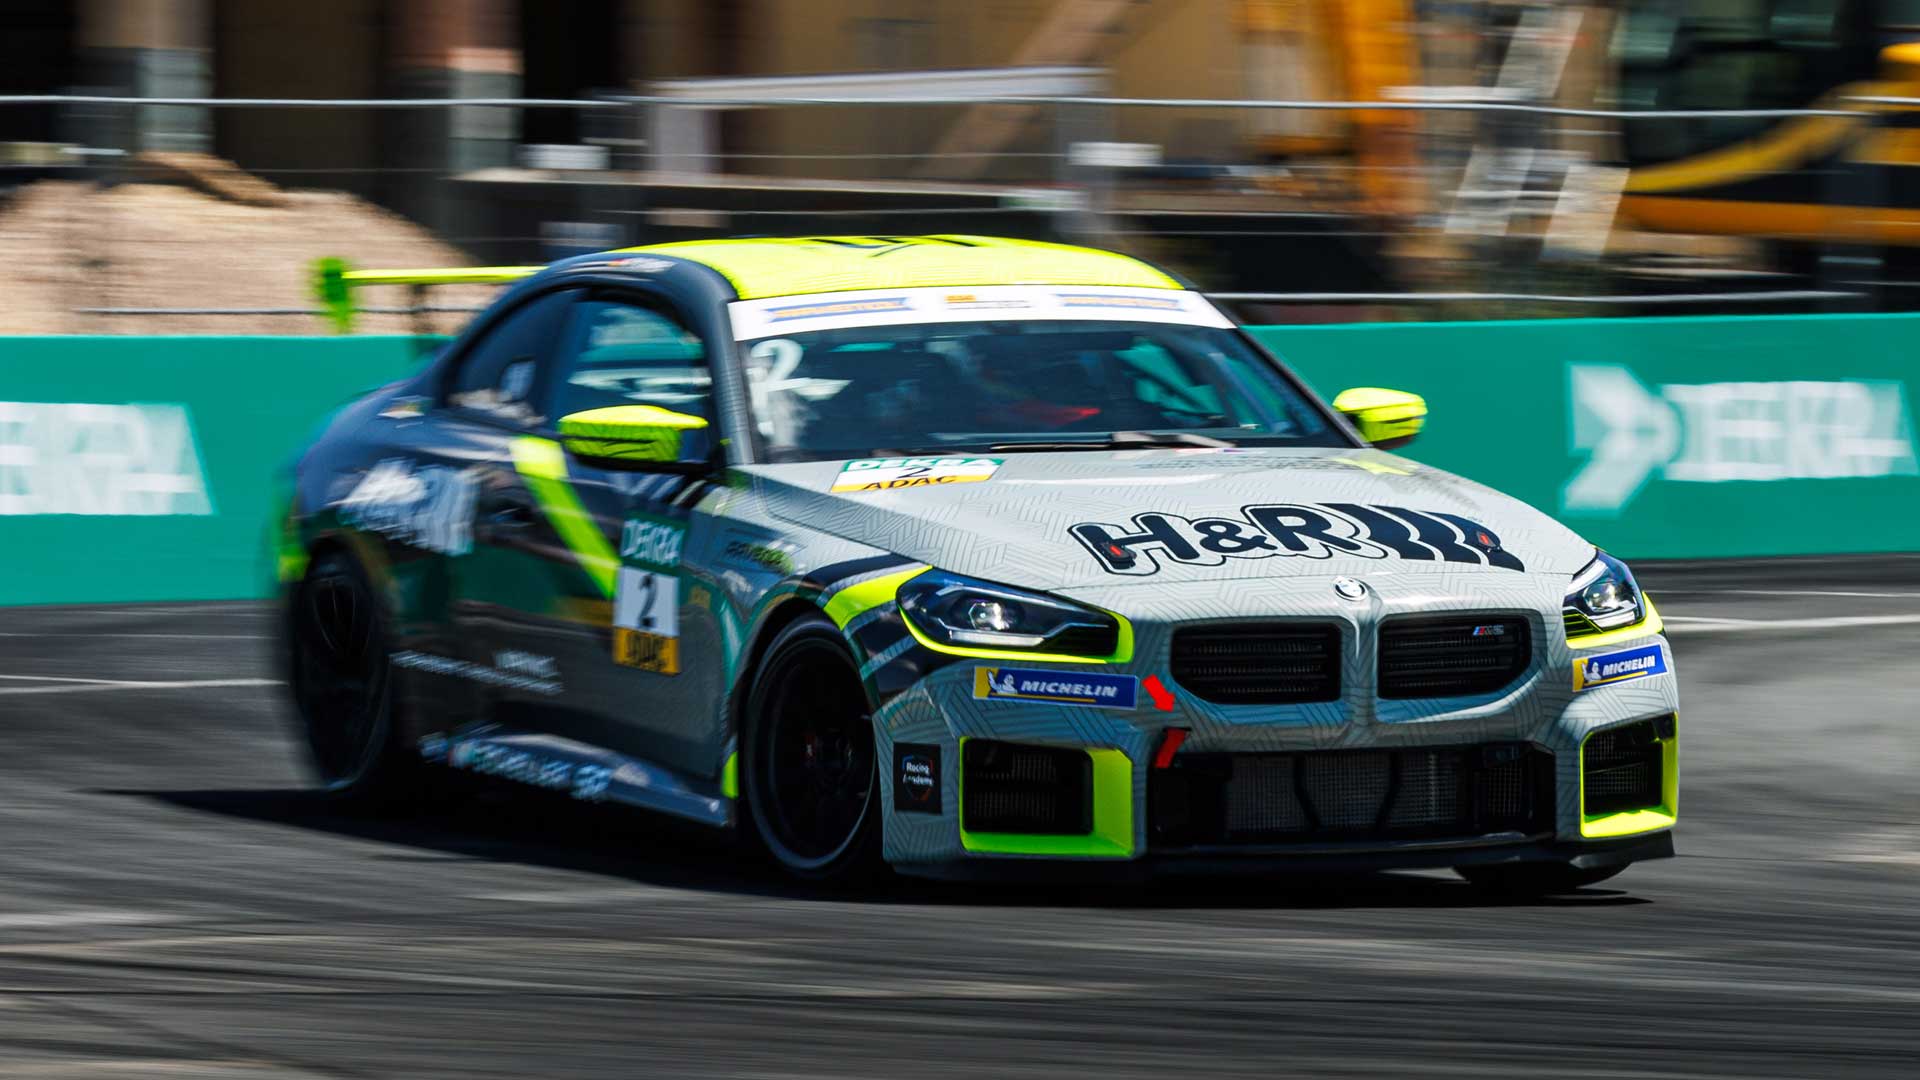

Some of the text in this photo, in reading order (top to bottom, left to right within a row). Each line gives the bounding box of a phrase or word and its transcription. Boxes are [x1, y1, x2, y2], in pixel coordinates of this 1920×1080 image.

[847, 458, 997, 472] DEKRA
[896, 467, 932, 479] 2
[862, 475, 958, 490] ADAC
[1068, 504, 1388, 576] H&R
[637, 571, 657, 629] 2
[1602, 655, 1656, 677] MICHELIN
[1020, 680, 1119, 698] MICHELIN
[906, 762, 930, 775] Racing
